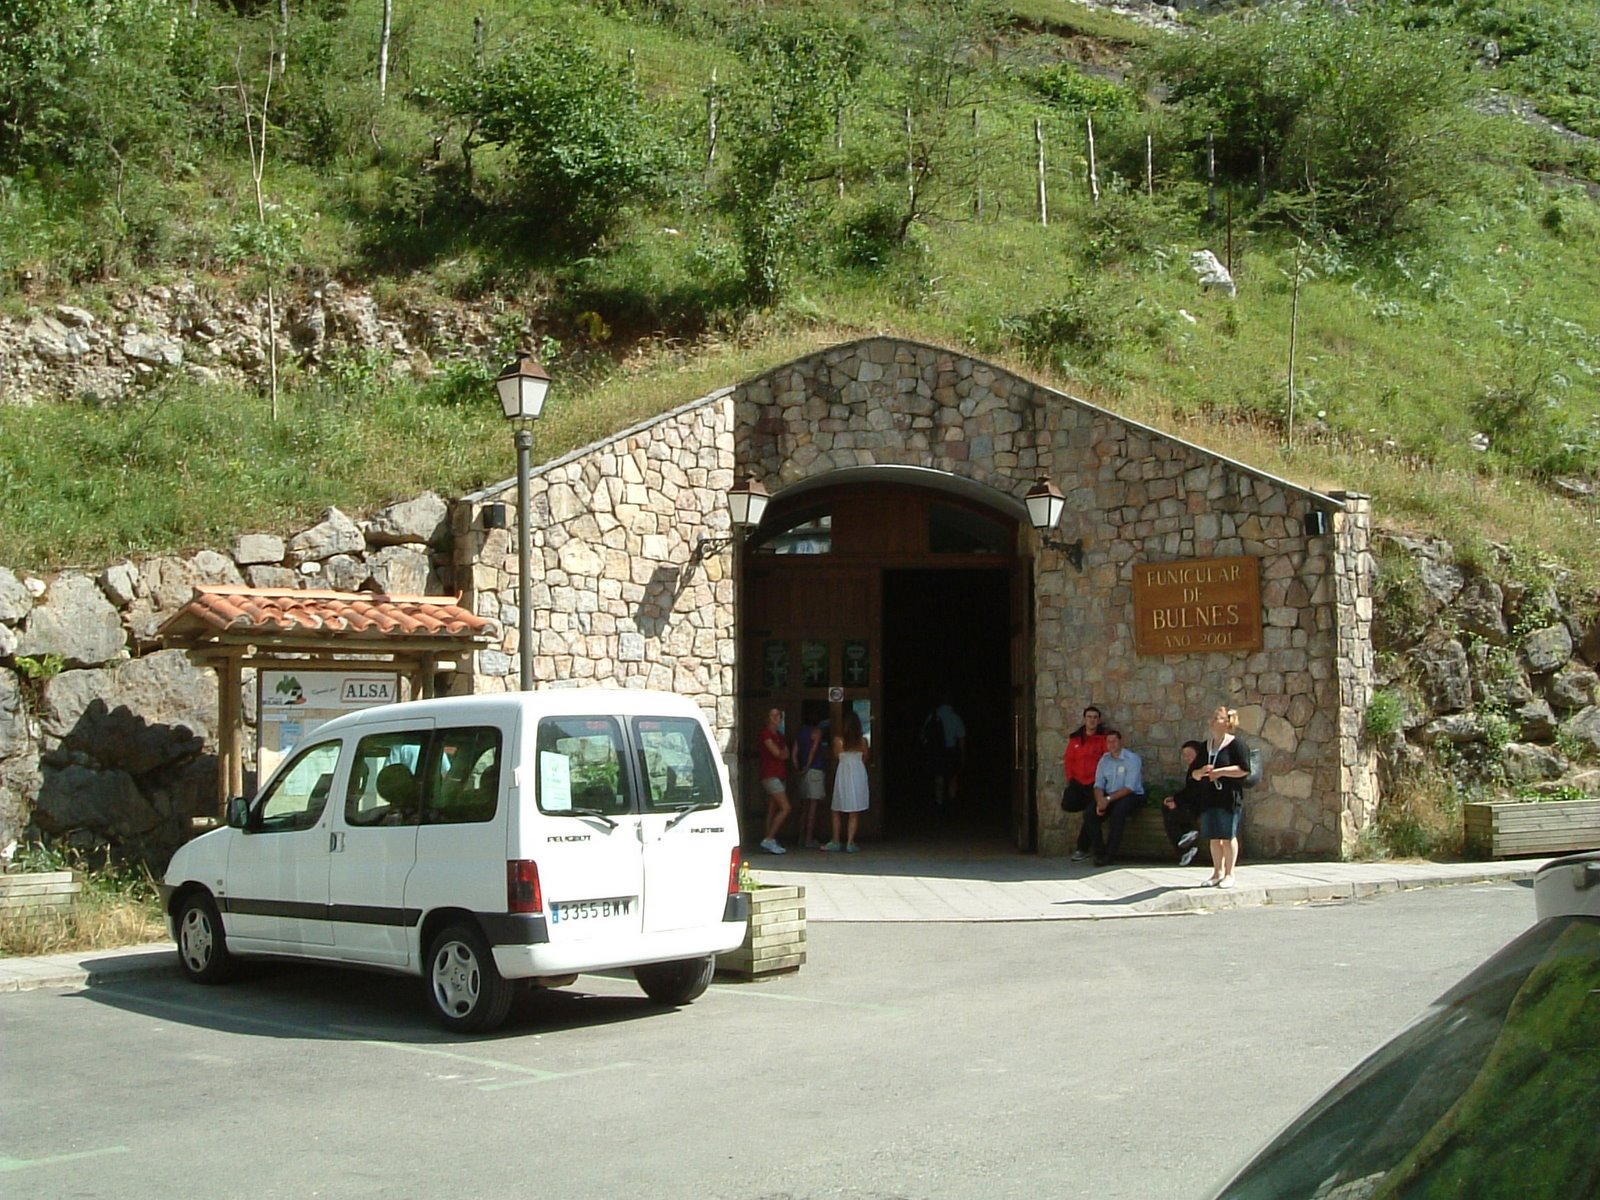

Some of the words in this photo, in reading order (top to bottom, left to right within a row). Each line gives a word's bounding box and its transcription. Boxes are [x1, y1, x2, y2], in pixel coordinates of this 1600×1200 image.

[1147, 565, 1240, 587] FUNICULAR
[1183, 587, 1203, 603] DE
[1153, 604, 1239, 630] BULNES
[1199, 632, 1233, 646] 2001
[346, 684, 389, 698] ALSA
[547, 834, 591, 843] PEUGEOT
[561, 903, 599, 921] 3355
